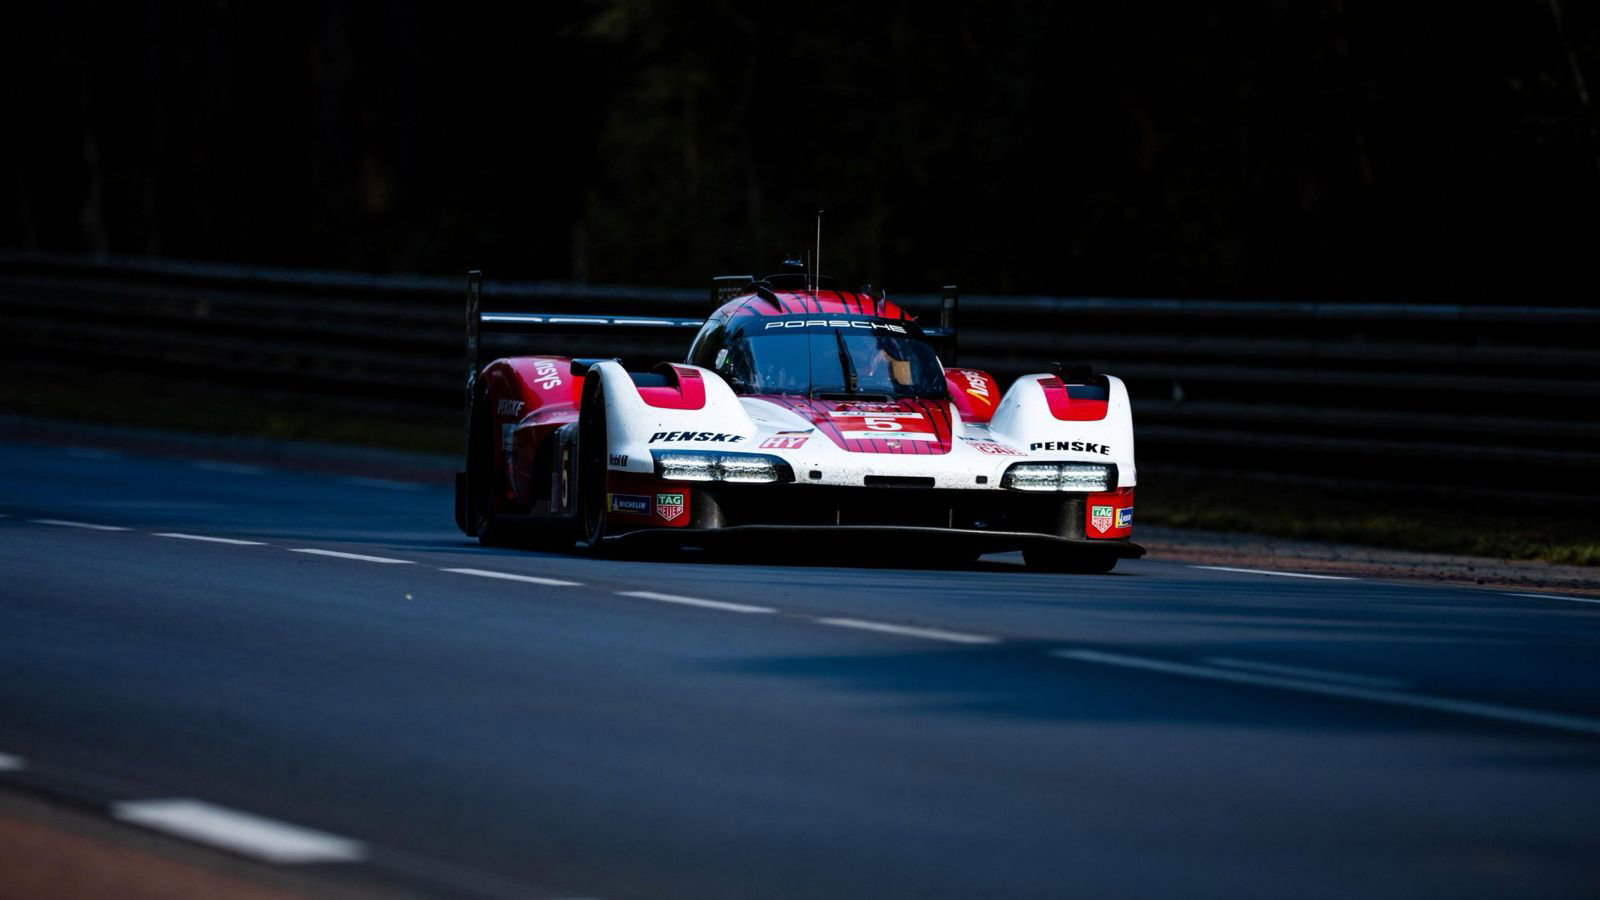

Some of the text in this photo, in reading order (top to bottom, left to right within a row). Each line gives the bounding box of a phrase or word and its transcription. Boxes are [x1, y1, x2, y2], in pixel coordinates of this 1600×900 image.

[765, 320, 907, 334] PORSCHE
[533, 359, 562, 390] nsys
[864, 417, 903, 431] 5
[648, 431, 746, 444] PENSKE
[1030, 441, 1111, 456] PENSKE
[561, 449, 569, 508] 5
[618, 500, 647, 509] MICHELIN
[659, 496, 681, 505] TAG
[657, 505, 683, 519] HEUER
[1094, 508, 1112, 517] TAG
